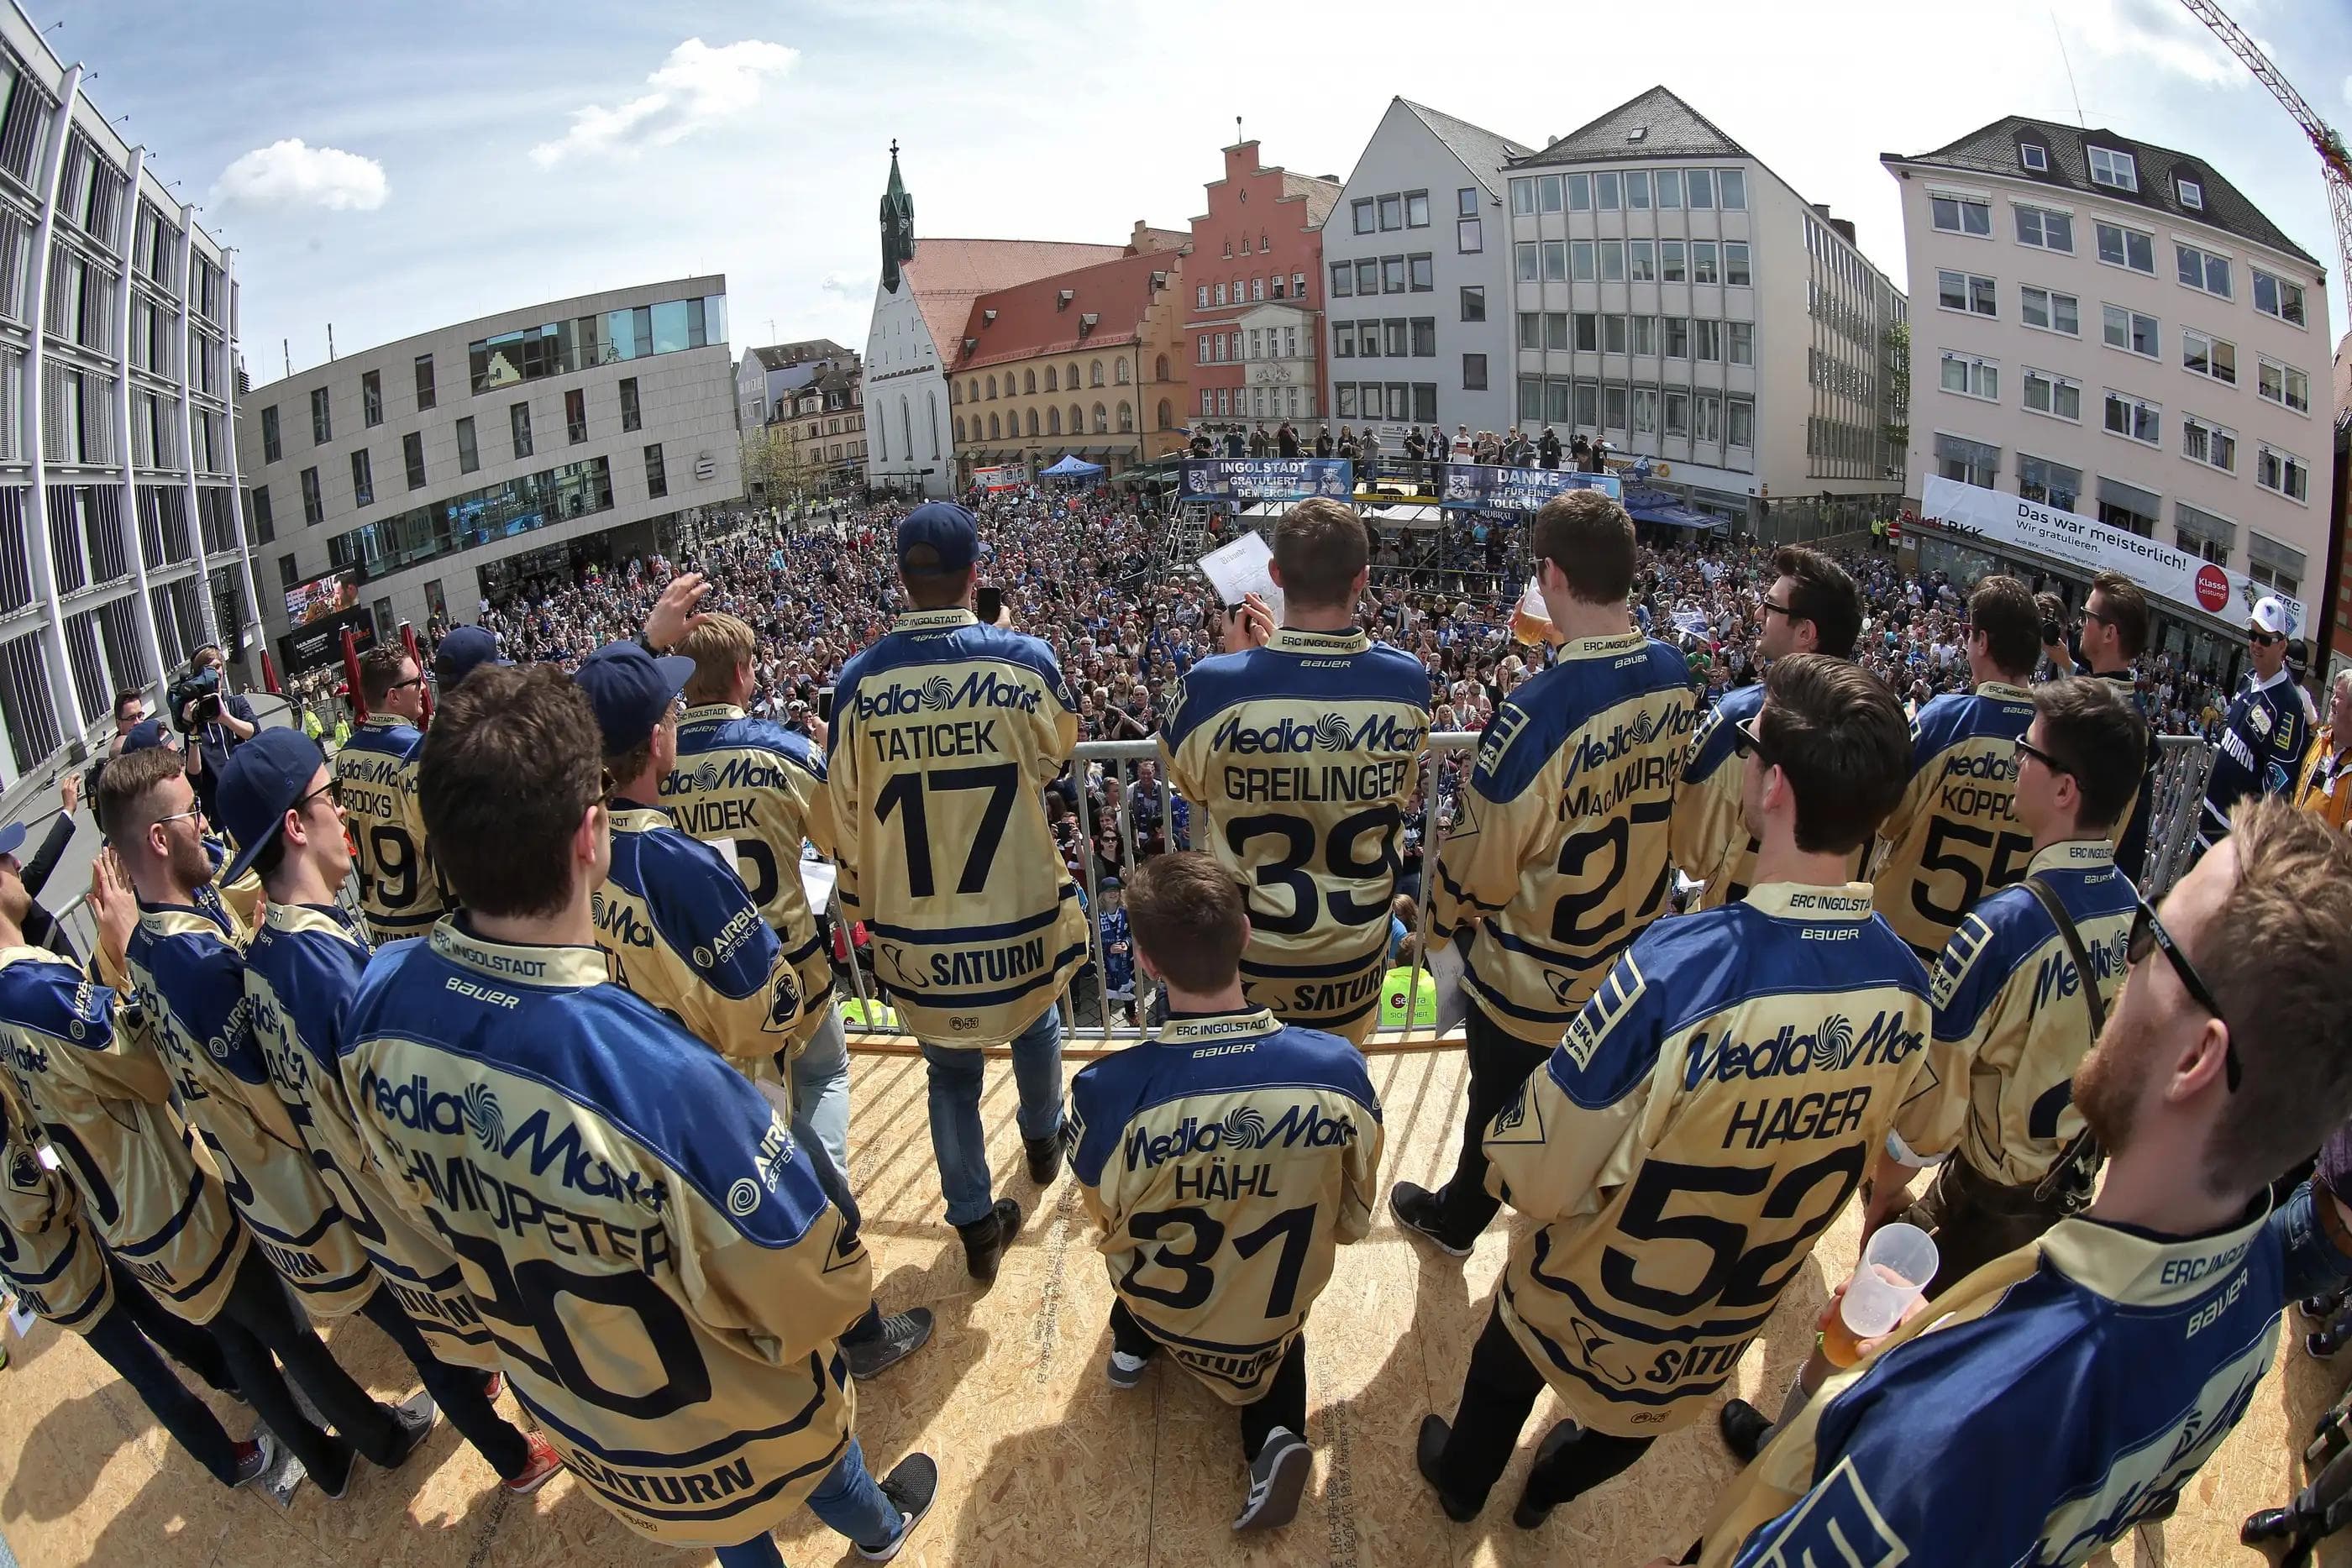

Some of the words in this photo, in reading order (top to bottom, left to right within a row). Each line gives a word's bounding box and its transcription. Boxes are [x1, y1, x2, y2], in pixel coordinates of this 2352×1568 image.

[1221, 462, 1308, 474] INGOLSTADT
[1230, 476, 1298, 485] GRATULIERT
[1497, 469, 1559, 486] DANKE
[1237, 488, 1260, 498] DEM
[1488, 498, 1521, 510] TOLLE
[1524, 499, 1546, 511] SAI
[1528, 489, 1551, 498] EINE
[1902, 509, 1942, 530] Audi
[1946, 519, 1984, 541] BKK
[2016, 519, 2037, 532] Wir
[2039, 526, 2101, 553] gratulieren.
[2018, 503, 2049, 523] Das
[2054, 517, 2086, 535] war
[2091, 527, 2187, 572] meisterlich!
[2198, 577, 2227, 591] Klasse
[2198, 587, 2226, 599] Leistung!
[2275, 594, 2301, 611] ERC
[894, 619, 909, 628] ERC
[908, 615, 963, 627] INGOLSTADT
[1282, 636, 1303, 647] ERC
[1304, 637, 1361, 650] INGOLSTADT
[1583, 642, 1603, 652] ERC
[688, 708, 727, 719] INGOLSTADT
[869, 720, 998, 762] TATICEK
[1214, 715, 1315, 753] Media
[1563, 725, 1635, 789] Media
[659, 769, 692, 796] dia
[1224, 760, 1409, 802] GREILINGER
[342, 789, 391, 819] BROOKS
[874, 762, 1018, 898] 17
[2070, 847, 2087, 857] ERC
[1226, 804, 1404, 935] 39
[1551, 799, 1672, 947] 27
[1790, 894, 1816, 908] ERC
[1817, 894, 1872, 911] INGOLSTA
[712, 901, 758, 956] AIRBU
[720, 921, 759, 963] DEFENCE
[452, 941, 546, 978] INGOLSTADT
[930, 937, 1044, 986] SATURN
[1176, 1024, 1198, 1036] ERC
[1200, 1017, 1270, 1035] INGOLSTADT
[1684, 1025, 1814, 1092] Media
[1722, 1087, 1872, 1150] HAGER
[1125, 1117, 1223, 1172] Media
[1176, 1156, 1278, 1201] HÄHL
[1600, 1141, 1866, 1316] 52
[2160, 1258, 2204, 1285] ERC
[571, 1447, 755, 1504] SATURN
